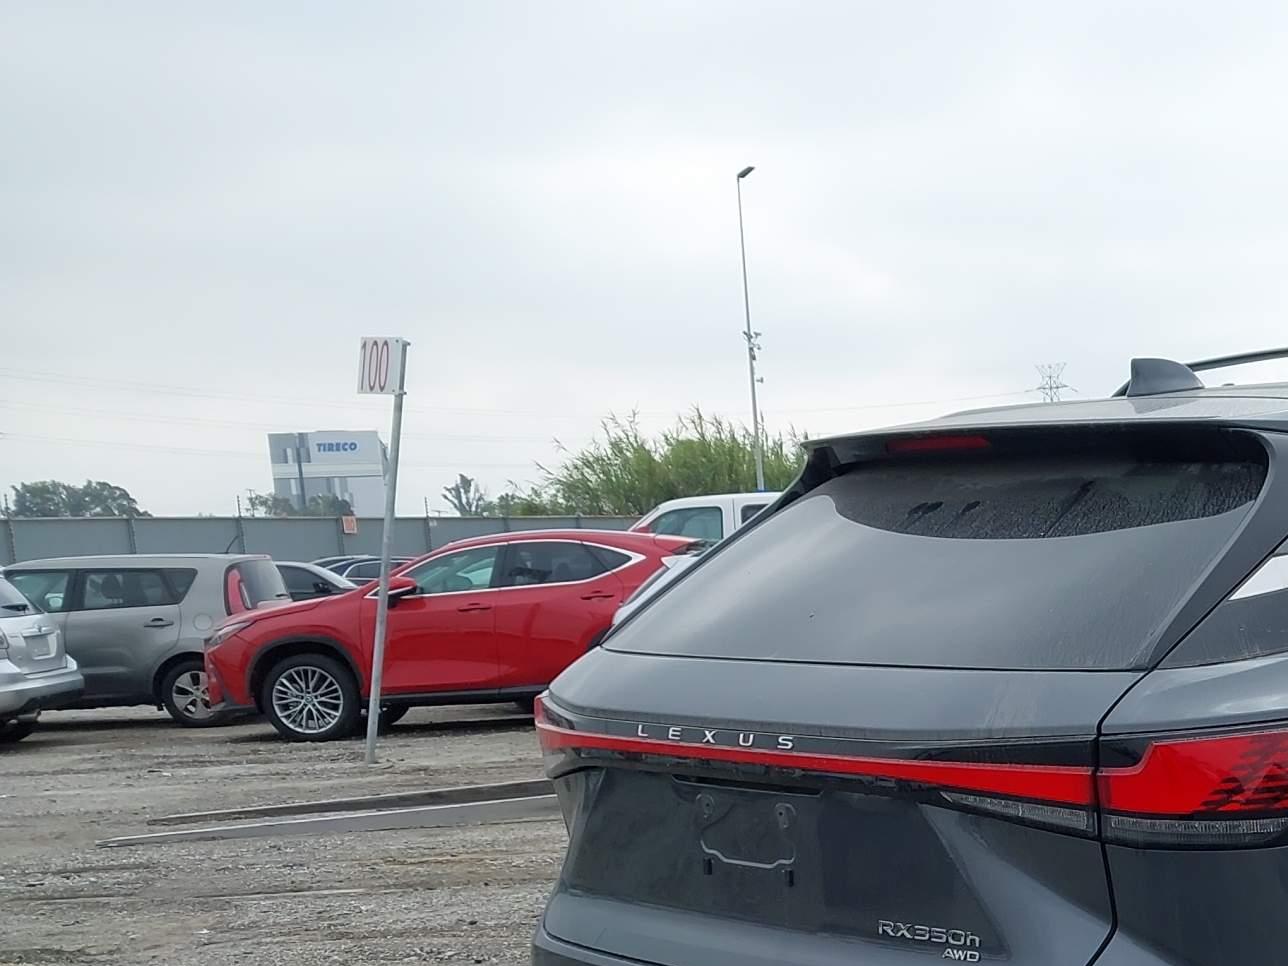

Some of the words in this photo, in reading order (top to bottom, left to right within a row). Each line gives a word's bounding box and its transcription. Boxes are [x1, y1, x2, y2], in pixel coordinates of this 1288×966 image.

[361, 340, 389, 392] 100
[316, 442, 358, 452] TIRECO
[637, 724, 794, 750] LEXUS
[878, 920, 980, 947] RX350h
[942, 948, 980, 962] AWD
